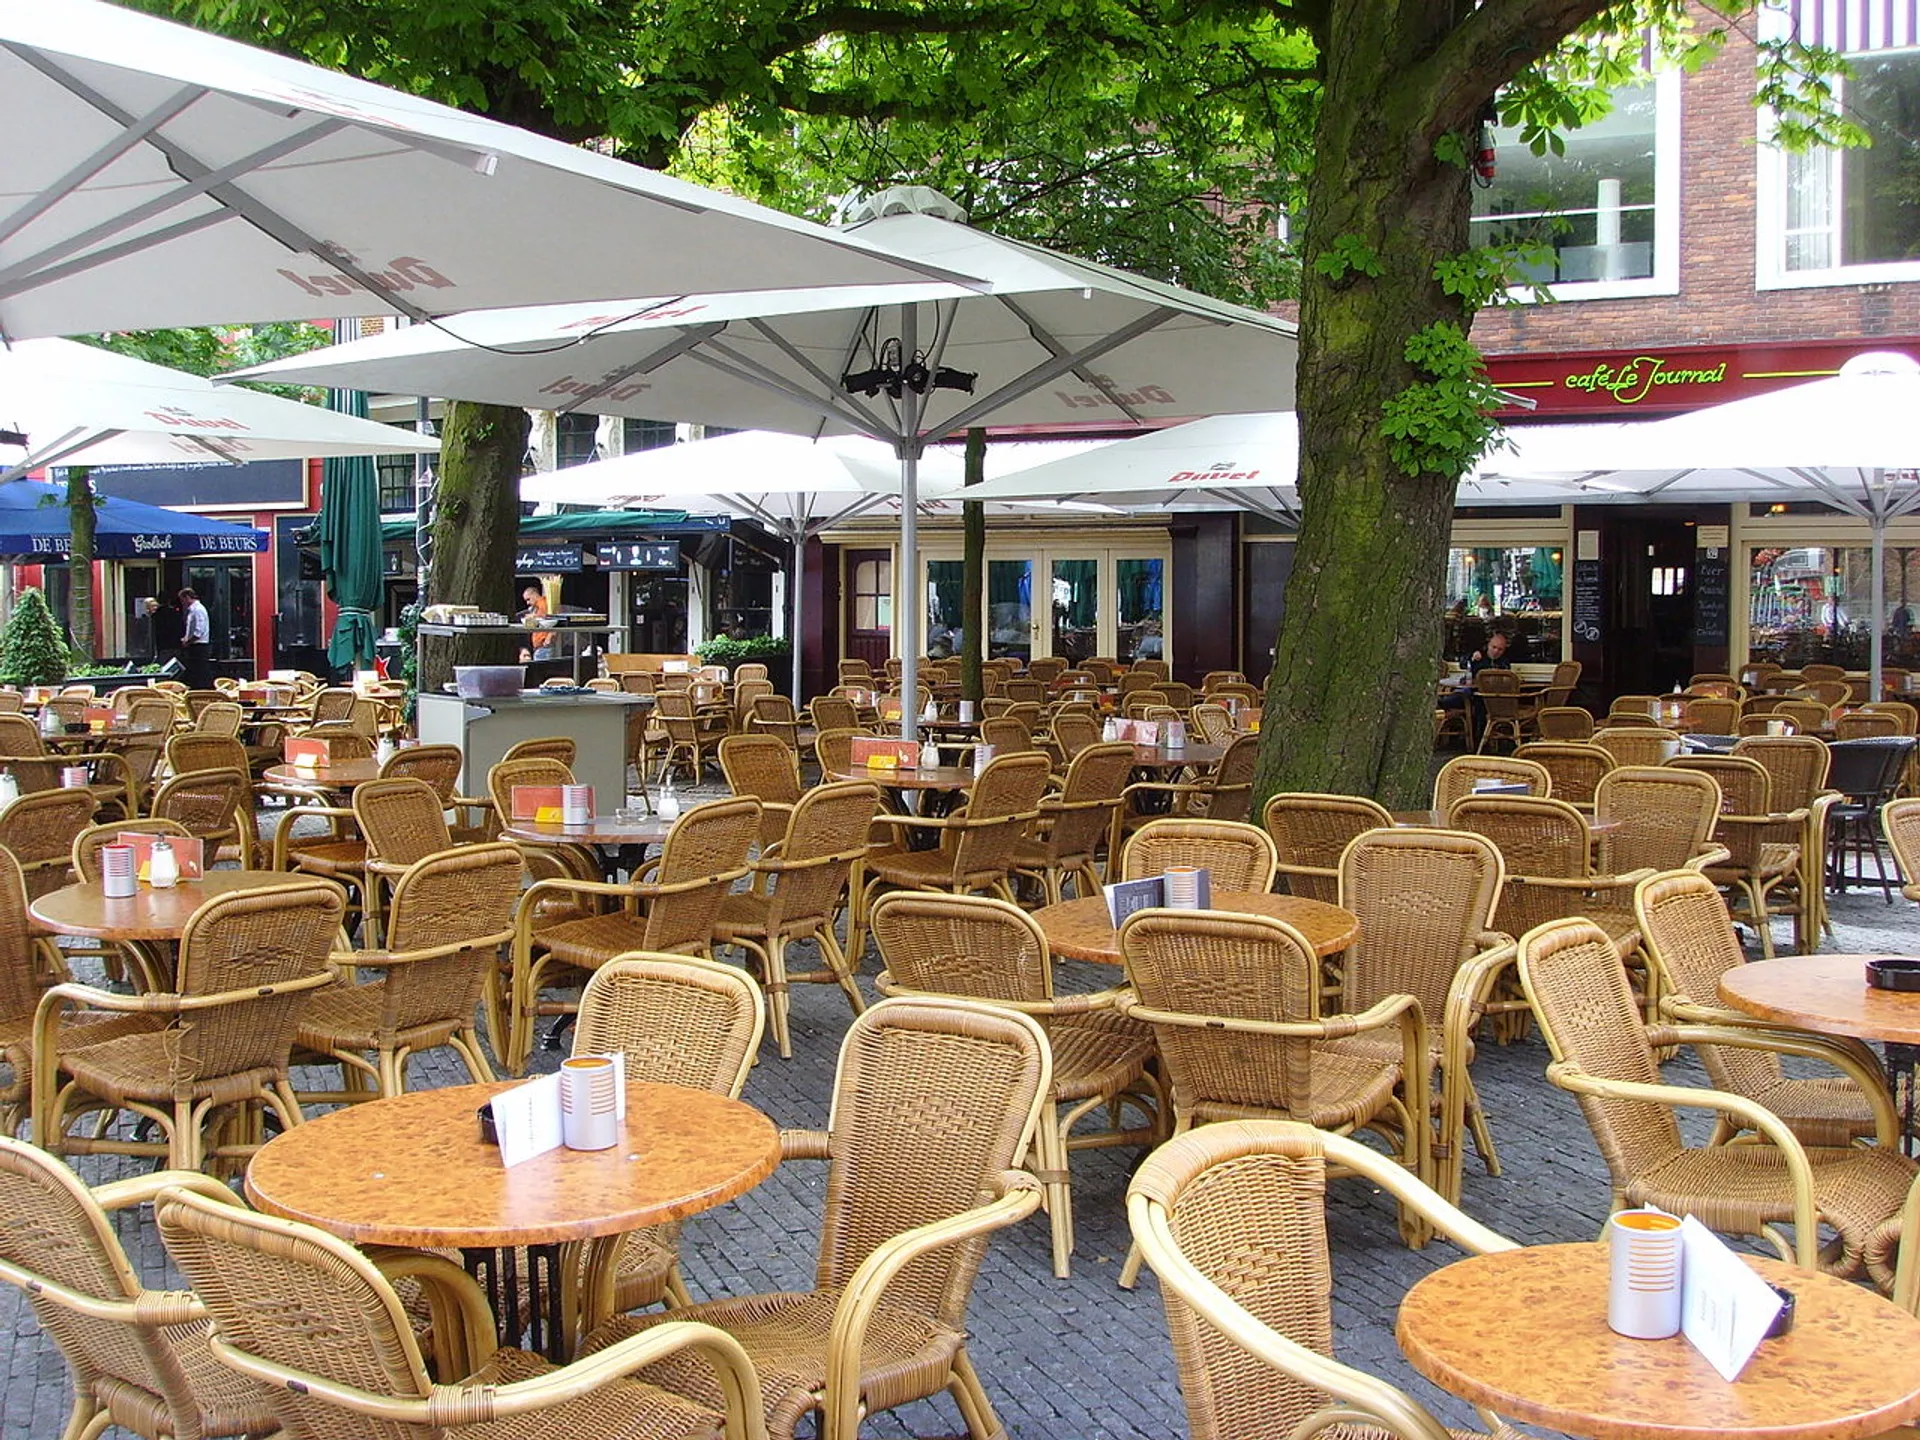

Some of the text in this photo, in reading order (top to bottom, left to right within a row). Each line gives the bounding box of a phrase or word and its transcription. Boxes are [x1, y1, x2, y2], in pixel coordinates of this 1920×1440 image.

[1565, 356, 1727, 404] café Le Journal
[1167, 470, 1261, 483] Duvel
[32, 537, 98, 553] DE BES
[131, 534, 173, 552] Grolsch
[200, 535, 258, 551] DE BEURS
